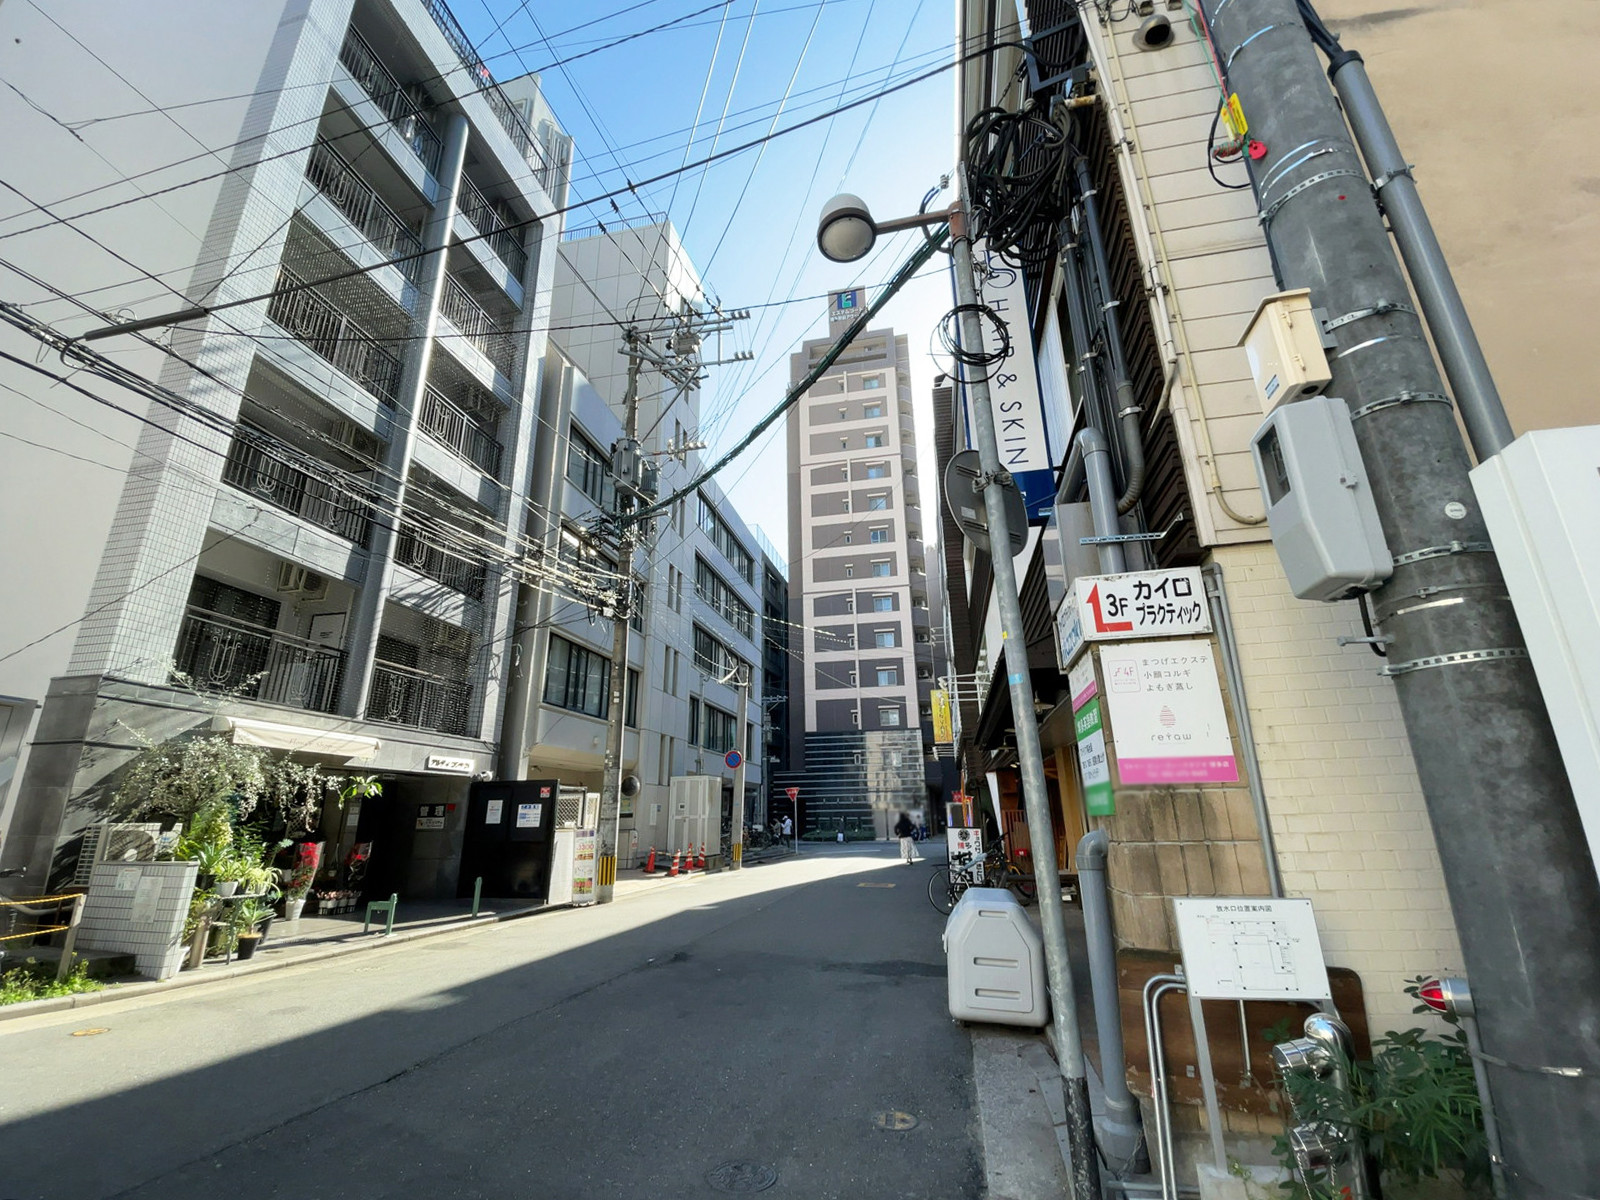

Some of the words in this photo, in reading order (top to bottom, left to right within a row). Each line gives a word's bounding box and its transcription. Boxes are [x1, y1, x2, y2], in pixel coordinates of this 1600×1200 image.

[996, 373, 1017, 390] &
[1000, 401, 1029, 465] SKIN
[1133, 577, 1192, 600] カイロ
[1106, 593, 1128, 617] 3F
[1136, 601, 1201, 626] プラクティック
[1142, 656, 1208, 666] まつげエクステ
[1143, 669, 1191, 680] 小顔コルギ
[1146, 682, 1193, 692] よもぎ蒸し
